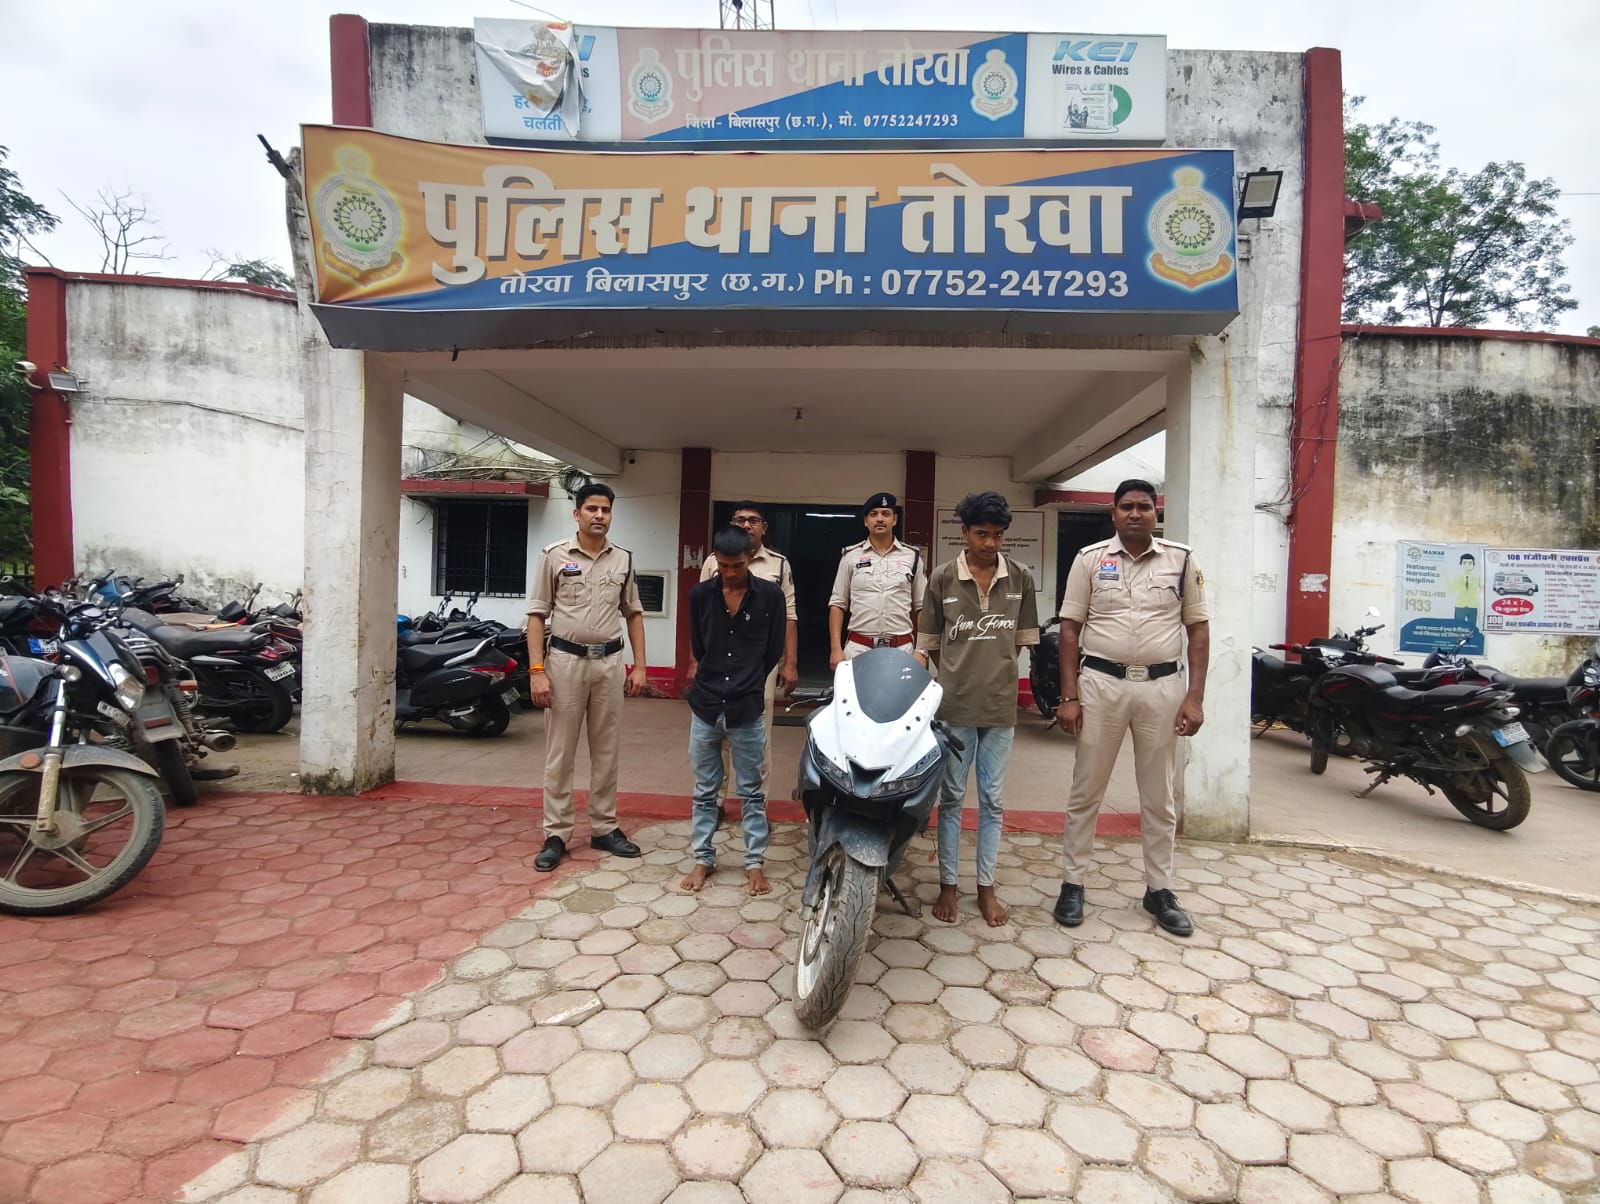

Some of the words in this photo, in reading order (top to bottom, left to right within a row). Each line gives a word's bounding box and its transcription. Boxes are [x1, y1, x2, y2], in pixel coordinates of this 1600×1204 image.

[1052, 40, 1139, 62] KEI
[674, 34, 777, 102] पुलिस
[787, 48, 865, 88] थाना
[876, 36, 970, 88] तोरवा
[1052, 64, 1082, 76] Wires
[1084, 65, 1092, 75] &
[1093, 64, 1129, 76] Cables
[522, 113, 561, 130] चलती
[728, 111, 780, 132] बिलासपुर
[839, 111, 857, 128] मो.
[863, 114, 958, 128] 07752247293
[418, 164, 663, 287] पुलिस
[684, 186, 878, 255] थाना
[897, 163, 1133, 255] तोरवा
[499, 269, 573, 295] तोरवा
[585, 267, 708, 300] बिलासपुर
[721, 272, 804, 294] (छ.ग.)
[813, 269, 854, 295] Ph
[881, 269, 1129, 298] 07752-247293
[1406, 563, 1437, 571] National
[1406, 570, 1440, 578] Narcotics
[1405, 598, 1432, 612] 1933
